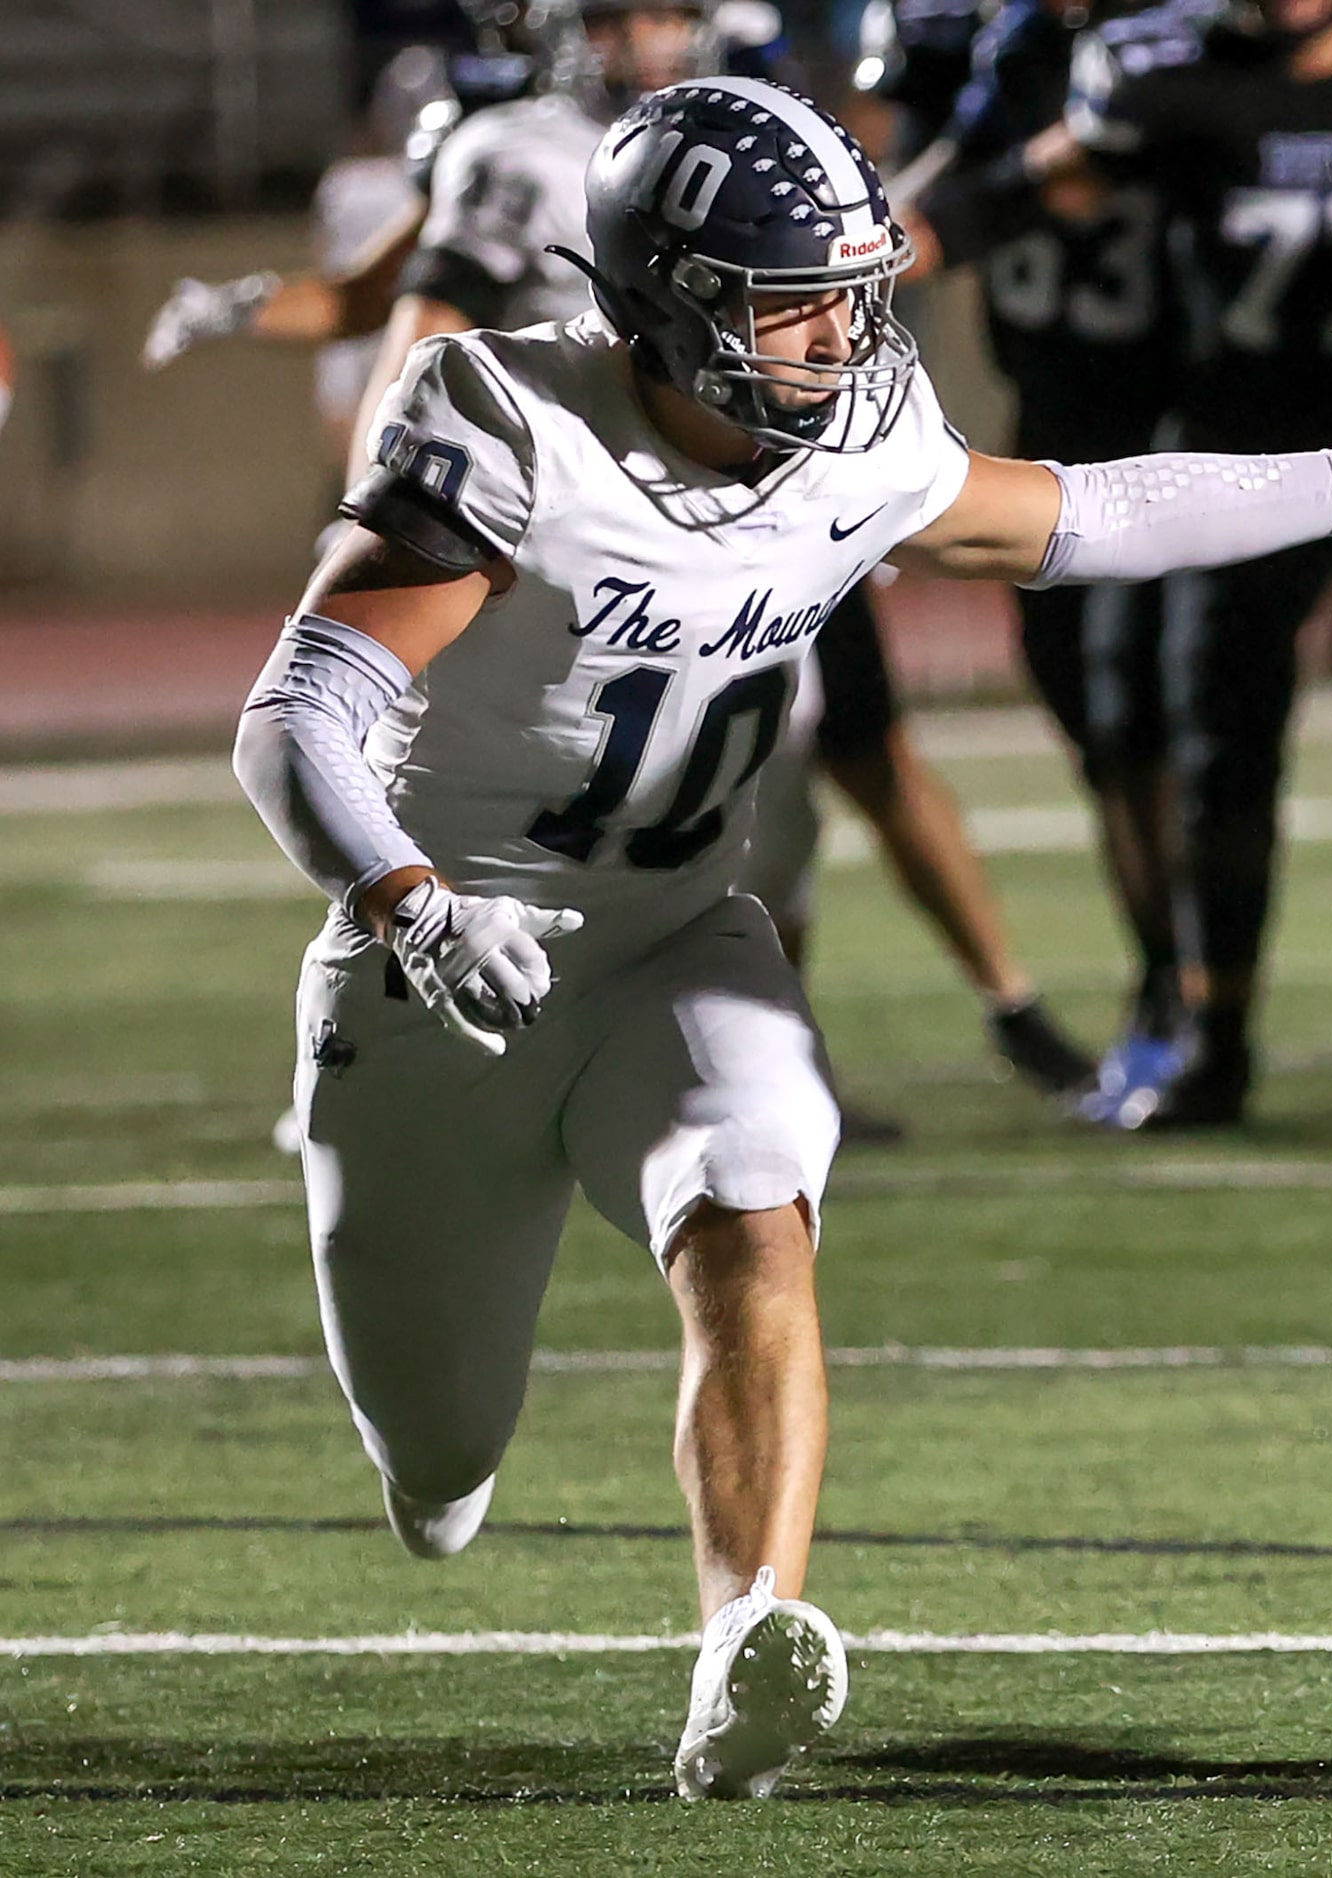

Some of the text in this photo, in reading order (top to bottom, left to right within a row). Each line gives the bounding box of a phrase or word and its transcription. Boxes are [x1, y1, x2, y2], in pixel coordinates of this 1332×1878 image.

[628, 130, 733, 231] 10
[568, 577, 682, 651] The
[522, 662, 799, 870] 10
